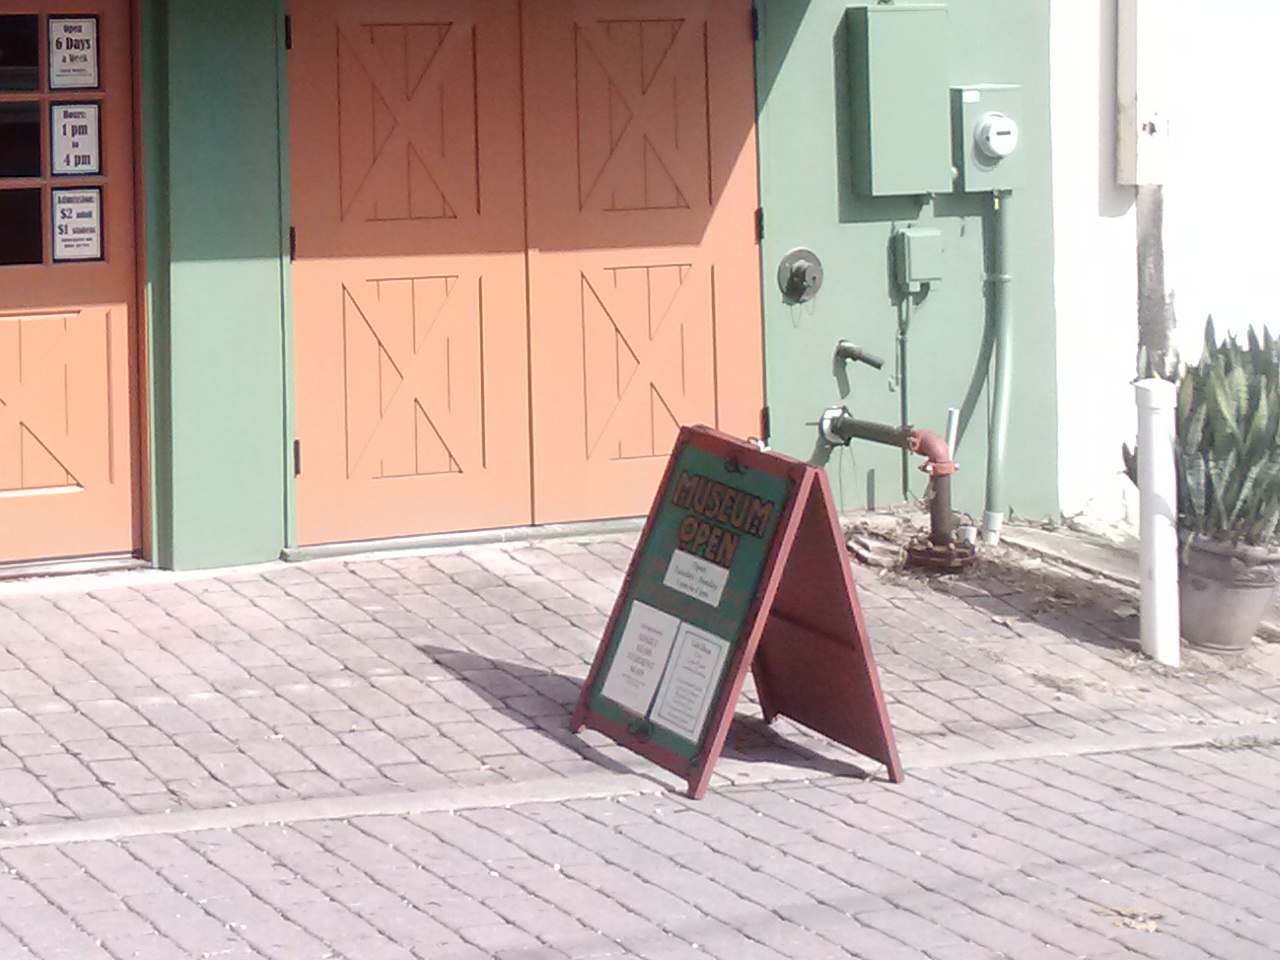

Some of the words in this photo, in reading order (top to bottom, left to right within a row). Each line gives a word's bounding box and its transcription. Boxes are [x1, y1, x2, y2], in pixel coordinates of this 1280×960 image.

[55, 37, 63, 50] 6
[66, 37, 91, 51] Days
[62, 123, 68, 136] 1
[71, 124, 89, 138] pm
[63, 153, 71, 166] 4
[74, 154, 91, 167] pm
[60, 207, 73, 220] $2
[57, 223, 68, 235] $1
[671, 469, 775, 539] MUSEUM
[678, 515, 740, 570] OPEN
